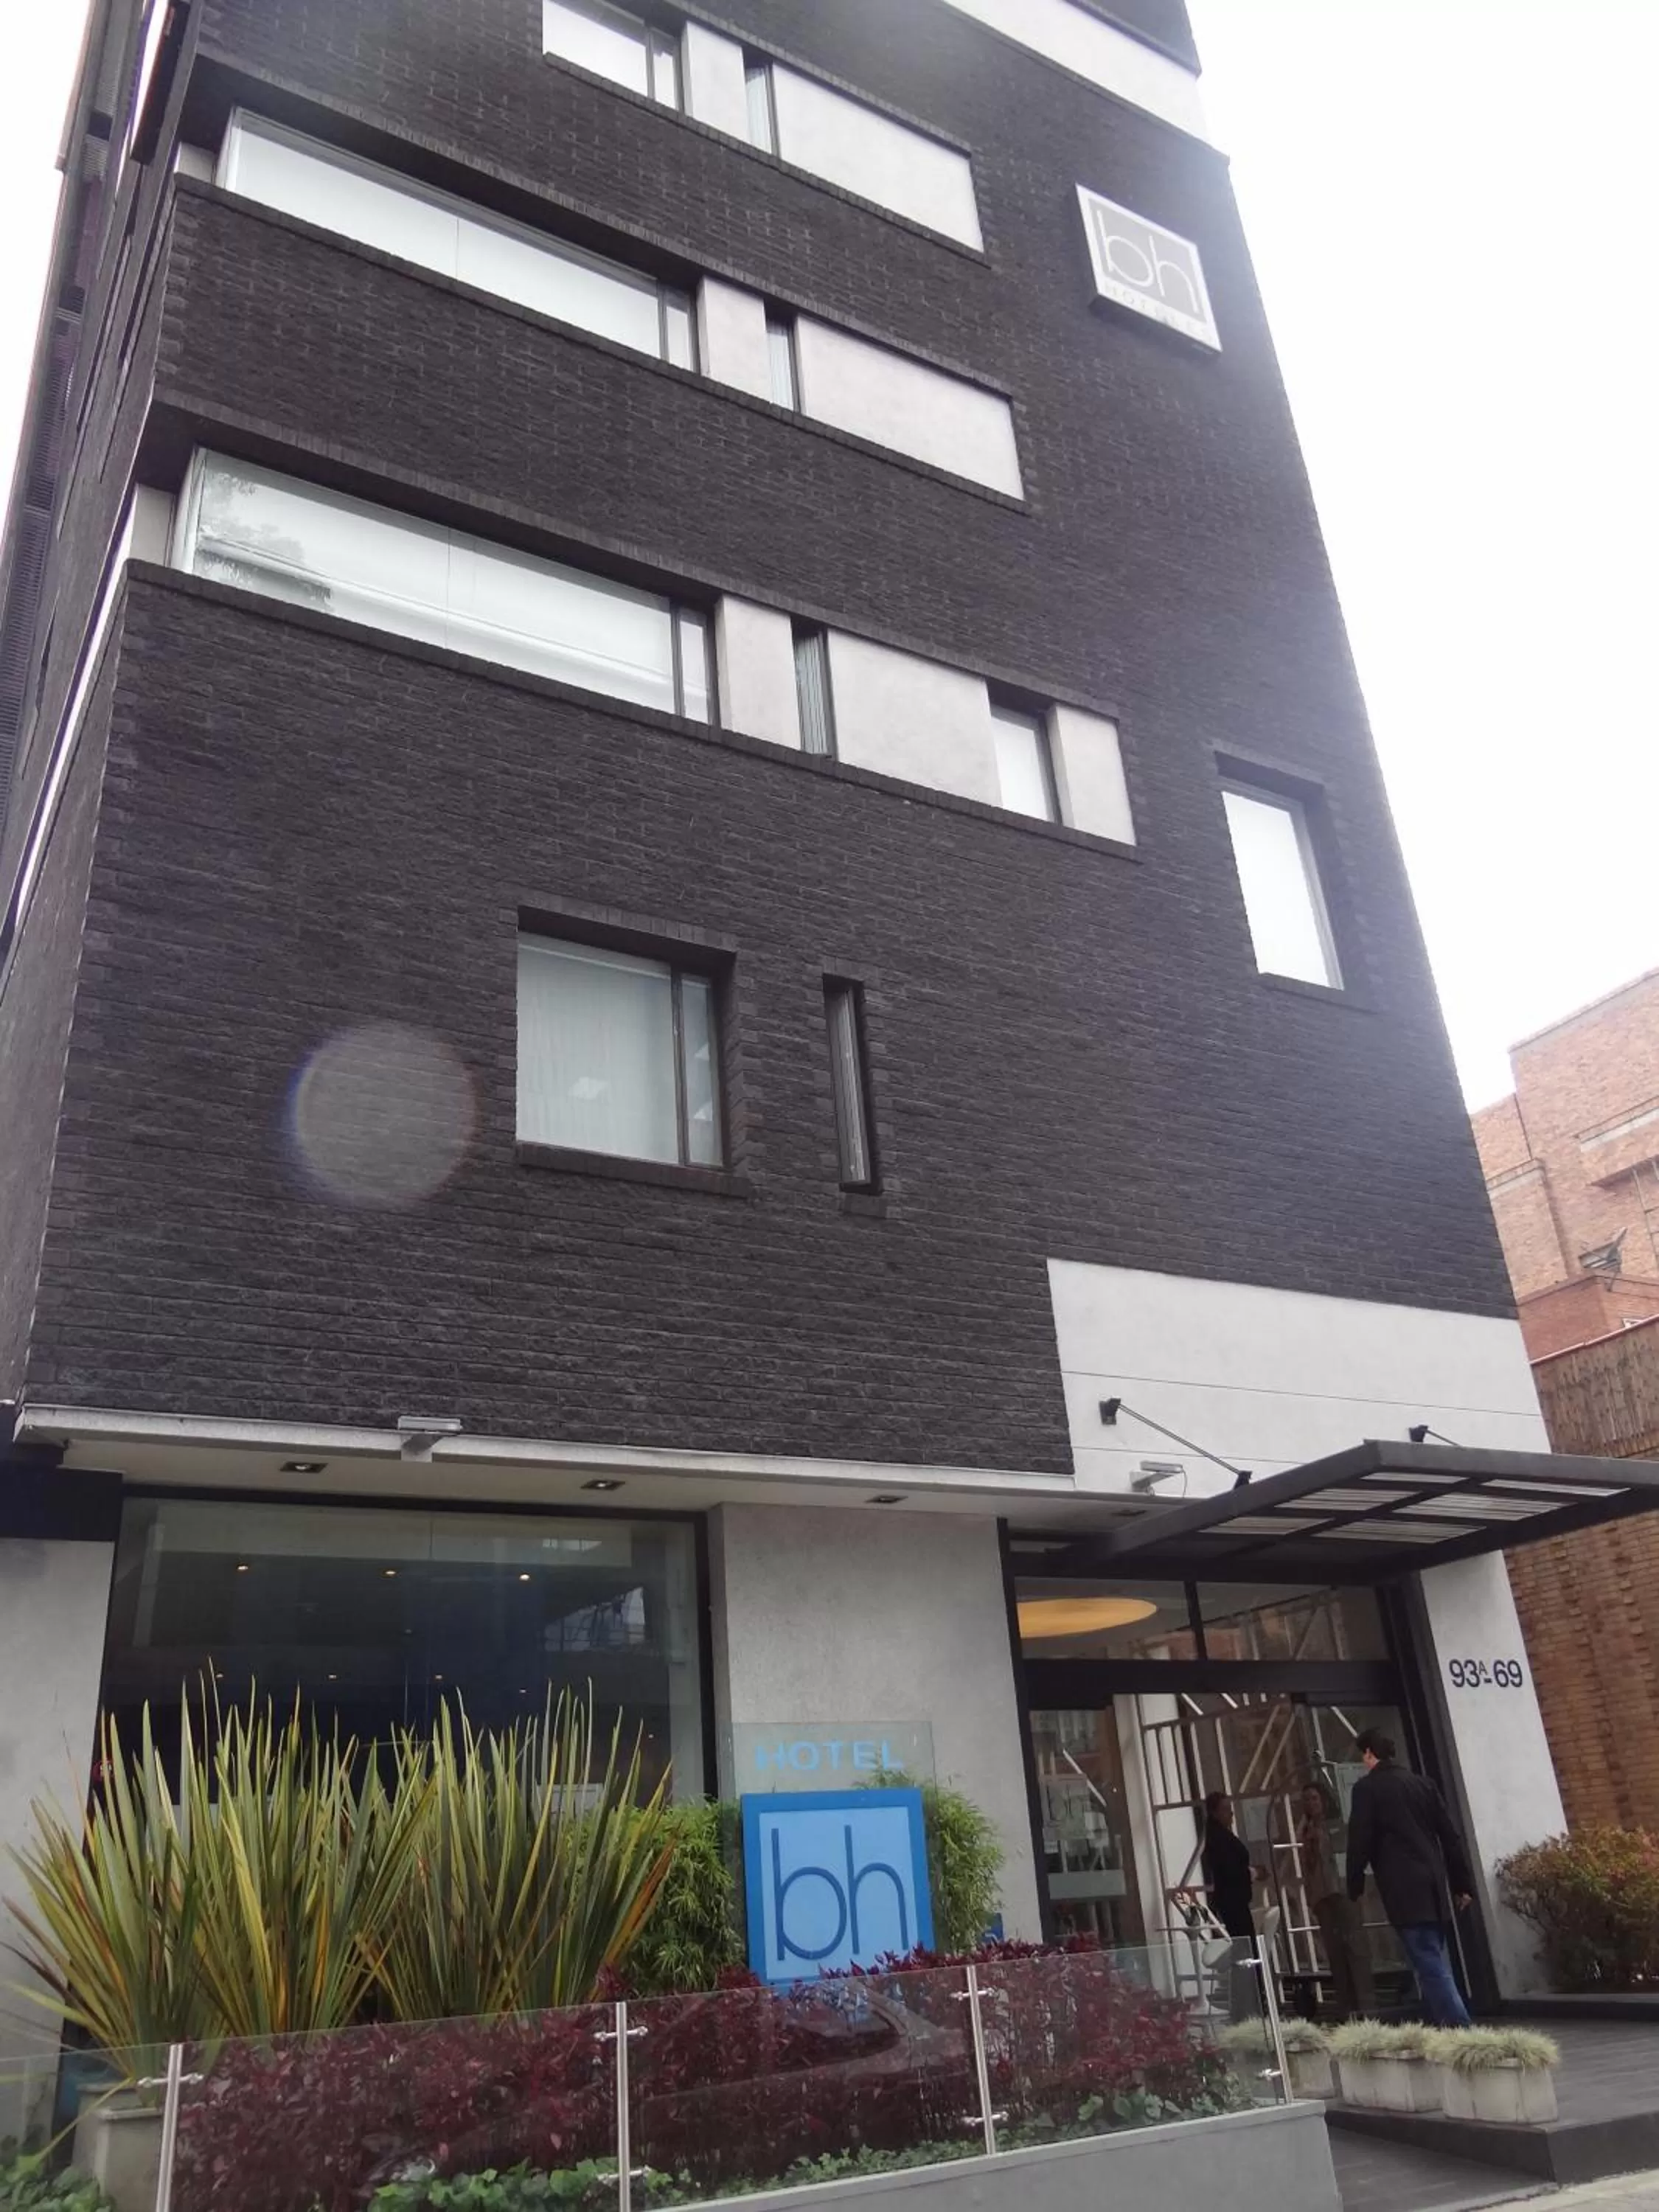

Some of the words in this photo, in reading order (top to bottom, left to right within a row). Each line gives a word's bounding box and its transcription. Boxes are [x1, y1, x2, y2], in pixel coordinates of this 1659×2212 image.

[1096, 209, 1199, 314] bh
[754, 1739, 903, 1770] HOTEL
[771, 1825, 909, 1961] bh
